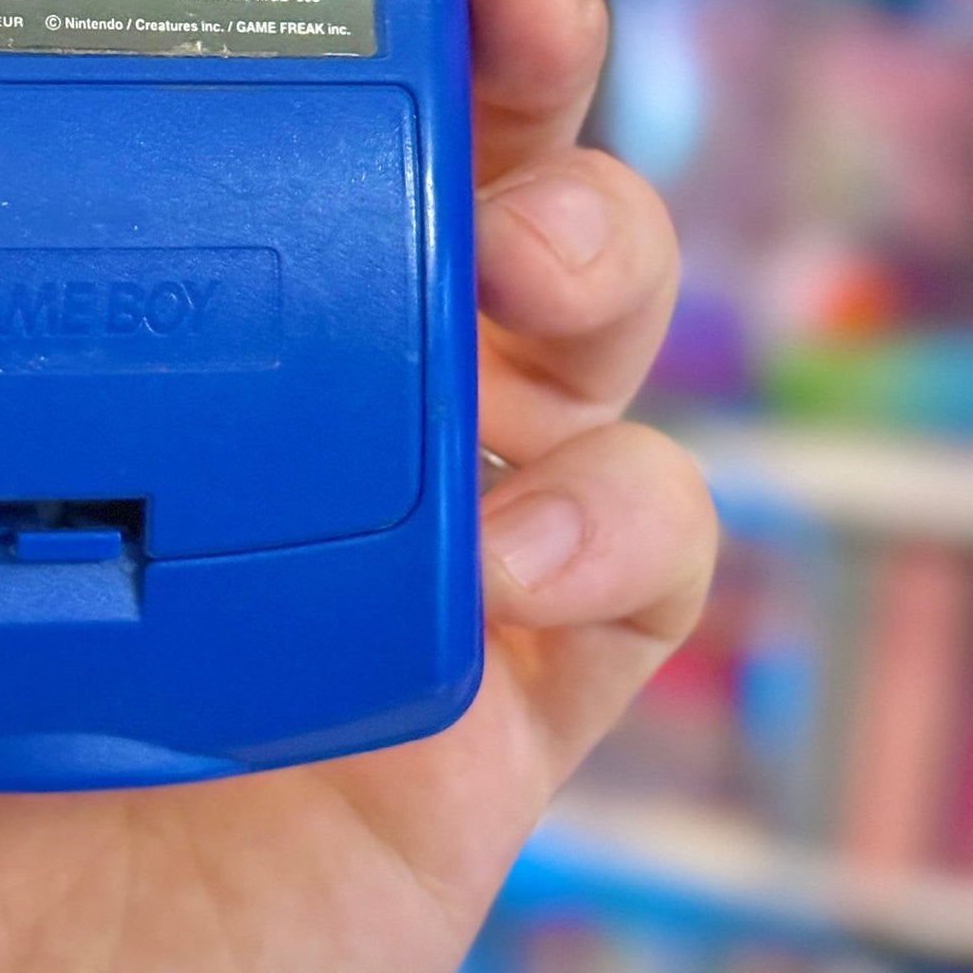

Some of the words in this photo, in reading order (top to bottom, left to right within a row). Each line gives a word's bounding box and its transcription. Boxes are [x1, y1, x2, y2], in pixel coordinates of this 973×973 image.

[65, 17, 123, 31] Nintendo
[135, 18, 198, 33] Creatures
[236, 21, 277, 34] GAME
[279, 22, 326, 35] FREAK
